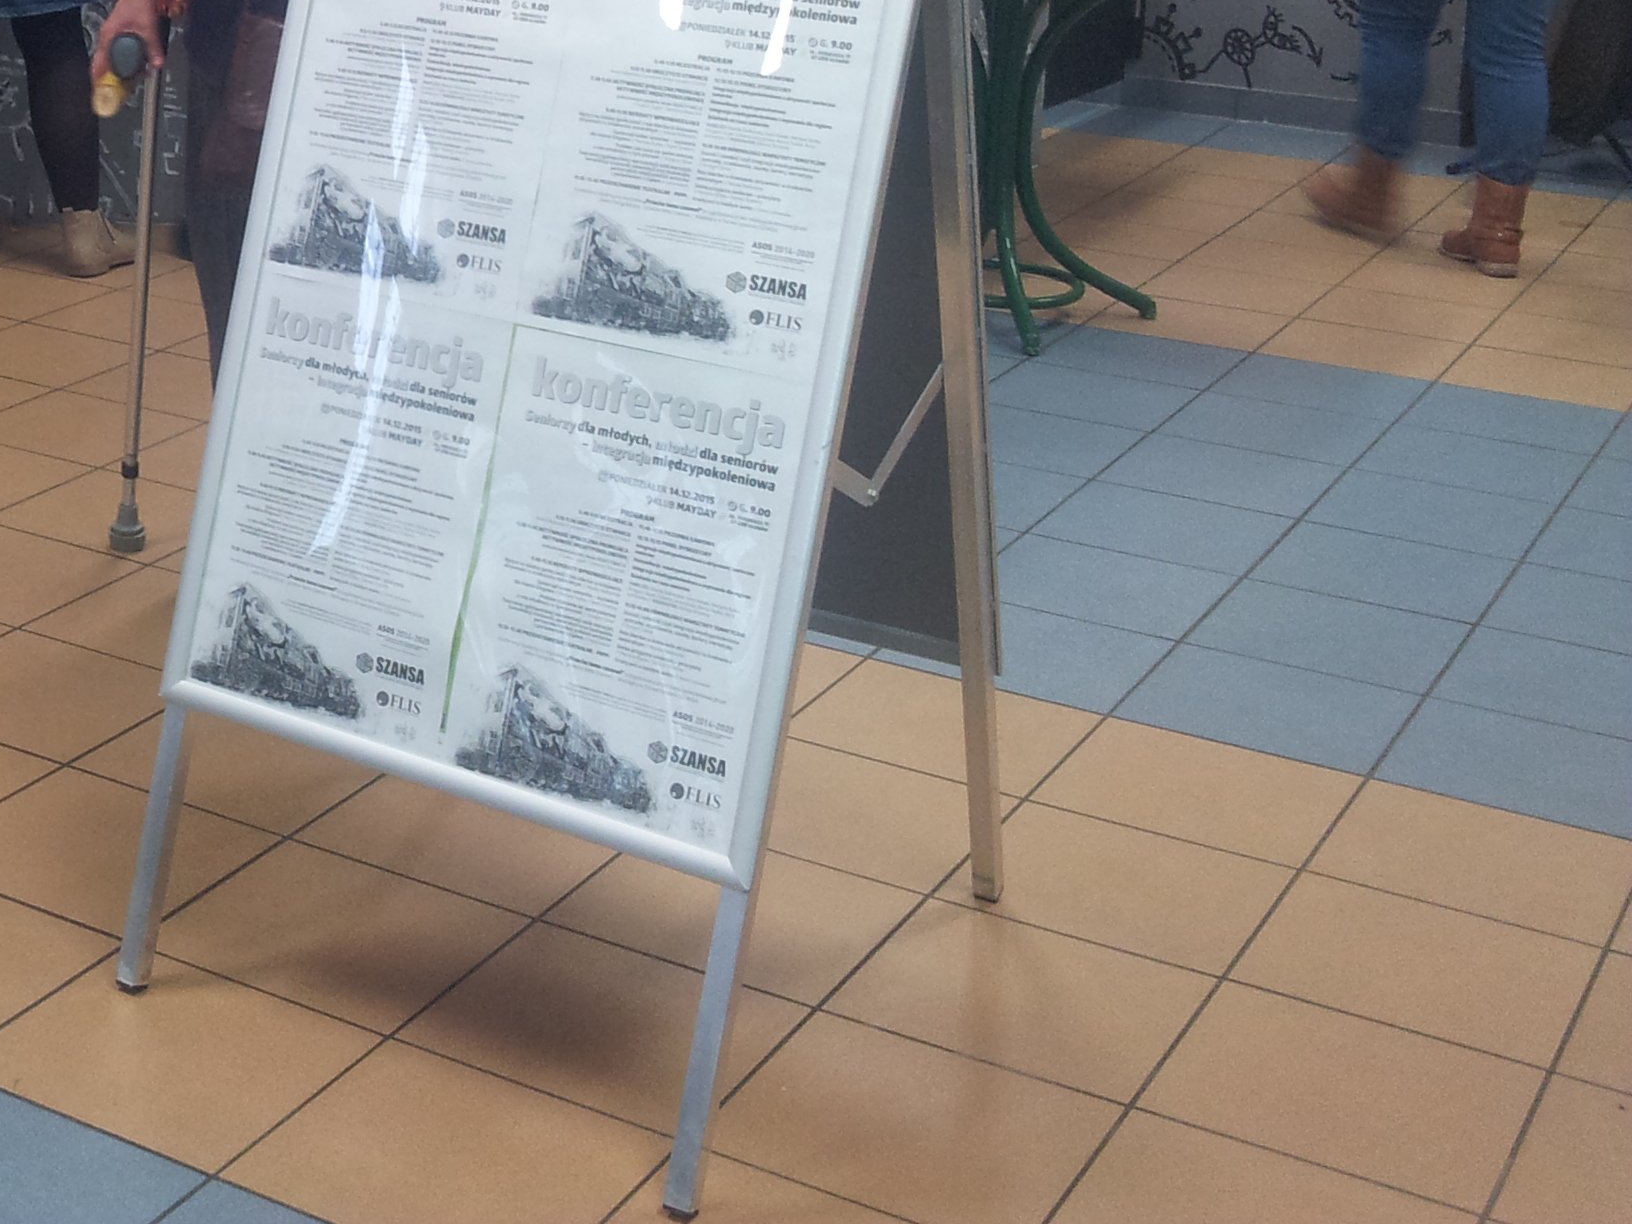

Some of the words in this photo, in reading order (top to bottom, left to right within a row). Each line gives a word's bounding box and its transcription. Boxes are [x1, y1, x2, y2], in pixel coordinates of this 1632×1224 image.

[465, 6, 501, 18] MAYDAY
[531, 2, 550, 12] 9.00
[686, 21, 747, 37] PONIEDZIAŁEK
[732, 41, 754, 51] KLUB
[831, 40, 853, 51] 9.00
[457, 221, 506, 244] SZANSA
[471, 254, 502, 273] FLIS
[749, 274, 807, 300] SZANSA
[766, 311, 803, 331] FLIS
[305, 357, 321, 369] dla
[410, 382, 426, 395] dla
[428, 386, 478, 406] seniorów
[531, 355, 785, 455] konferencja
[382, 417, 422, 434] 14.12.2015
[387, 431, 423, 447] MAYDAY
[577, 421, 595, 435] dla
[598, 424, 652, 448] młodych,
[699, 447, 717, 462] dla
[720, 452, 779, 475] seniorów
[652, 454, 776, 492] międzypokoleniowa
[669, 486, 715, 504] 14.12.2015
[676, 501, 717, 519] MAYDAY
[750, 504, 771, 518] 9.00
[375, 656, 424, 685] SZANSA
[390, 694, 421, 715] FLIS
[670, 745, 726, 778] SZANSA
[686, 786, 721, 809] FLIS
